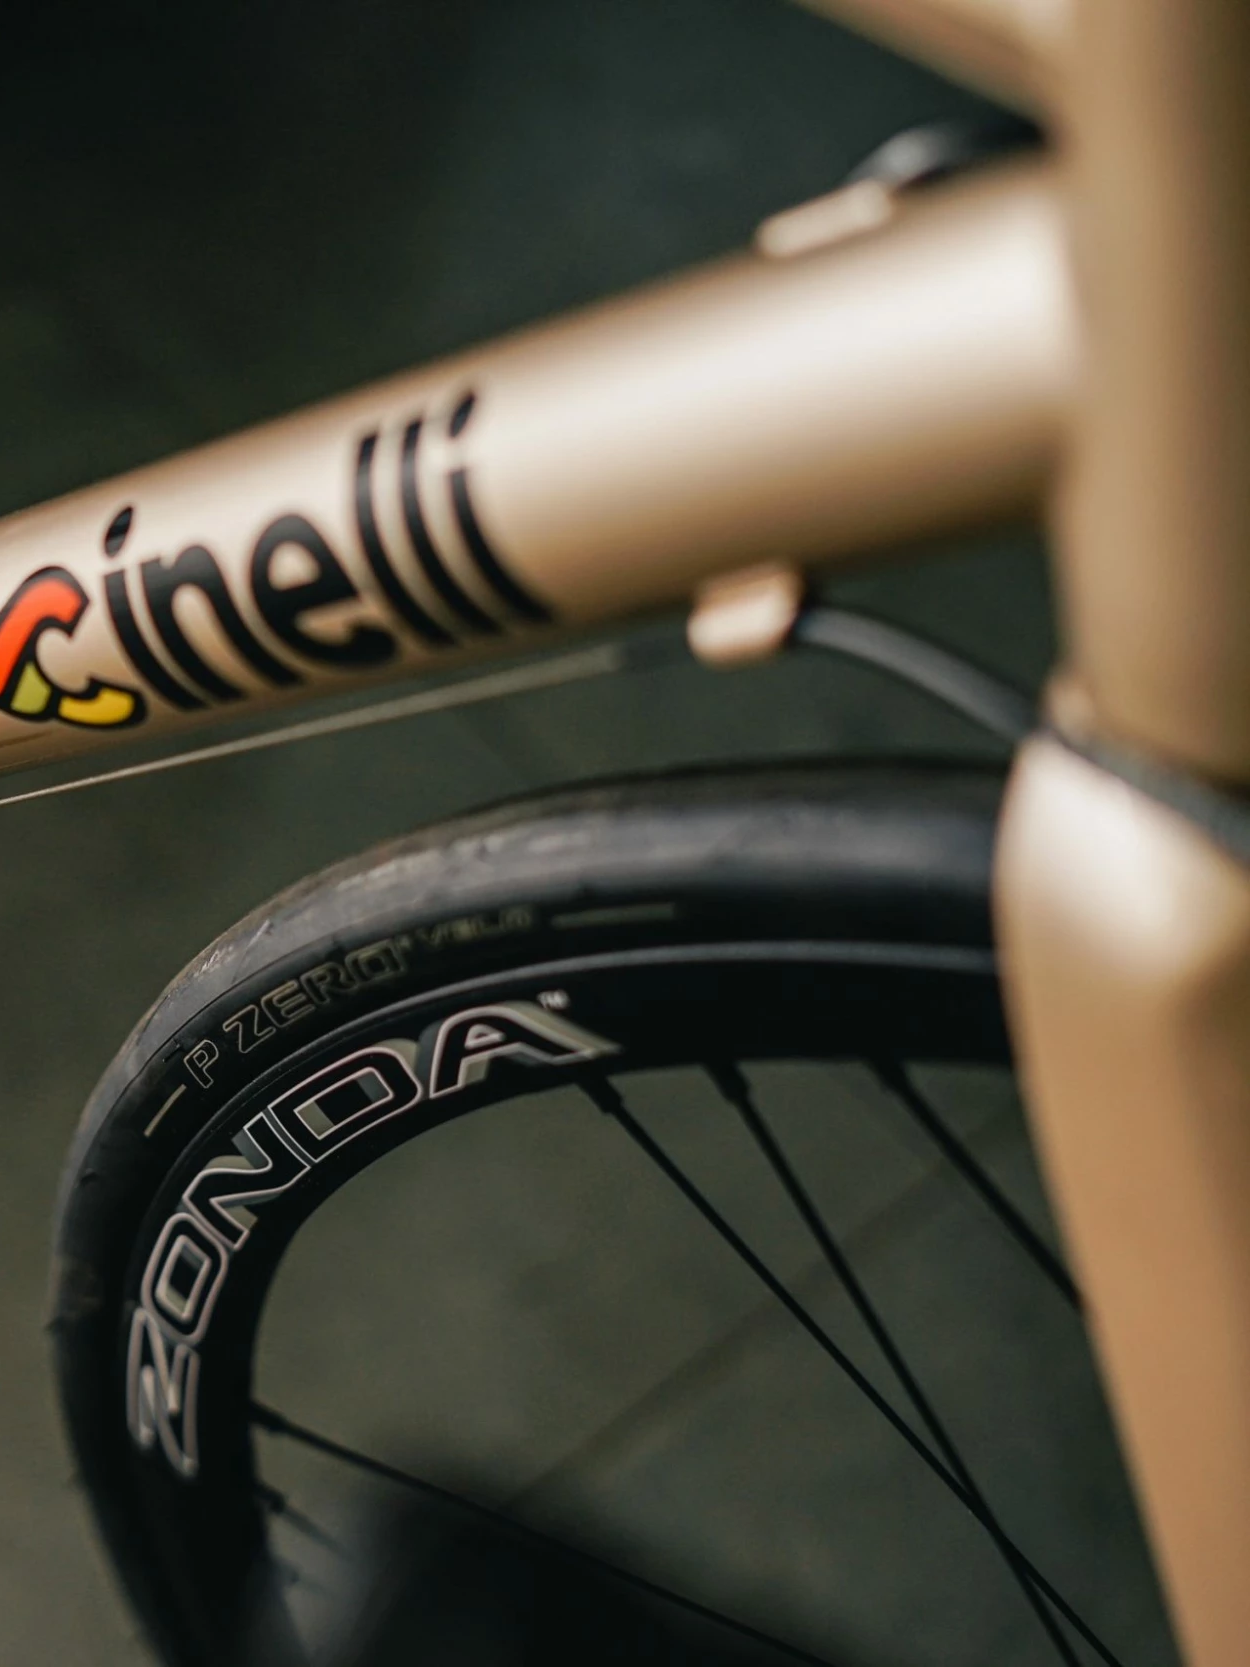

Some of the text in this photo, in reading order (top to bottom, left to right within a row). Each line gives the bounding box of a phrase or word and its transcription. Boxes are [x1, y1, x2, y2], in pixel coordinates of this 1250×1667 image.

[183, 1039, 220, 1090] P
[222, 941, 409, 1055] ZERO
[127, 1002, 622, 1477] ZONDA
